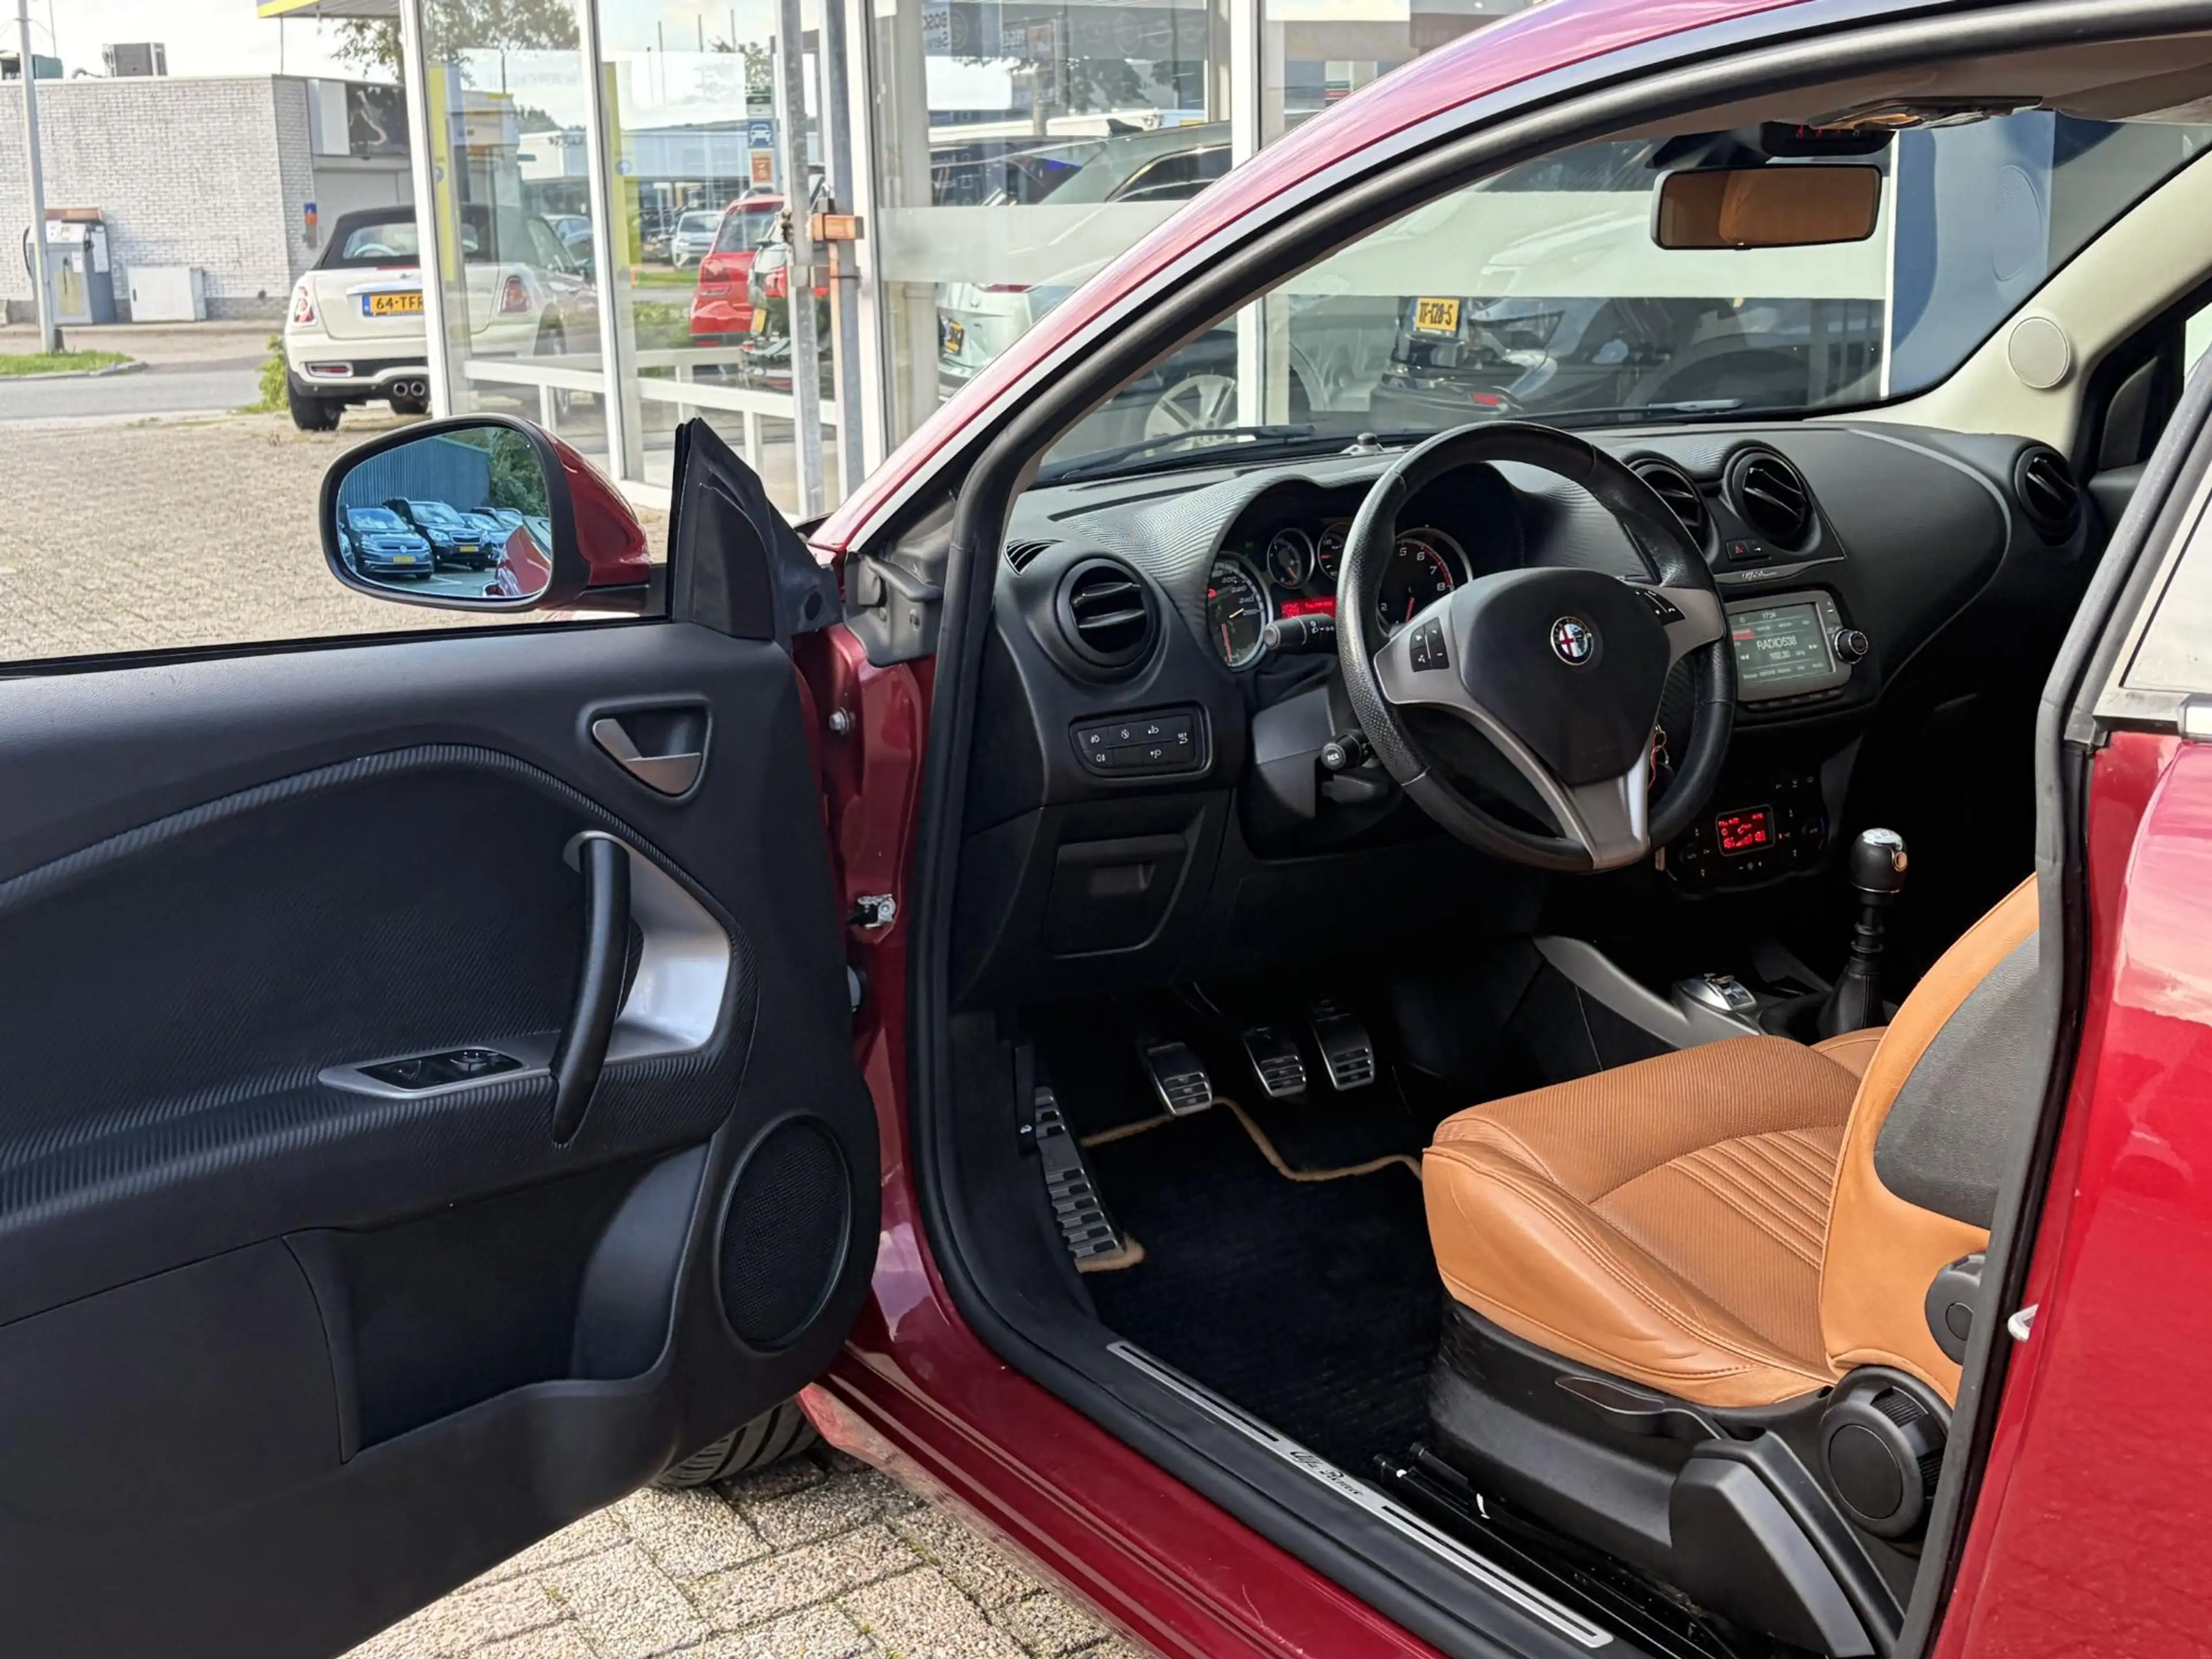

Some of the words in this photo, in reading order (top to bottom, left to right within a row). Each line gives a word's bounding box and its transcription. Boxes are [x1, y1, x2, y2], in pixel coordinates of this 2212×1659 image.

[1399, 547, 1408, 556] 5
[1416, 551, 1425, 561] 6
[1429, 565, 1438, 575] 7
[1436, 582, 1445, 591] 8
[1380, 603, 1388, 611] 2
